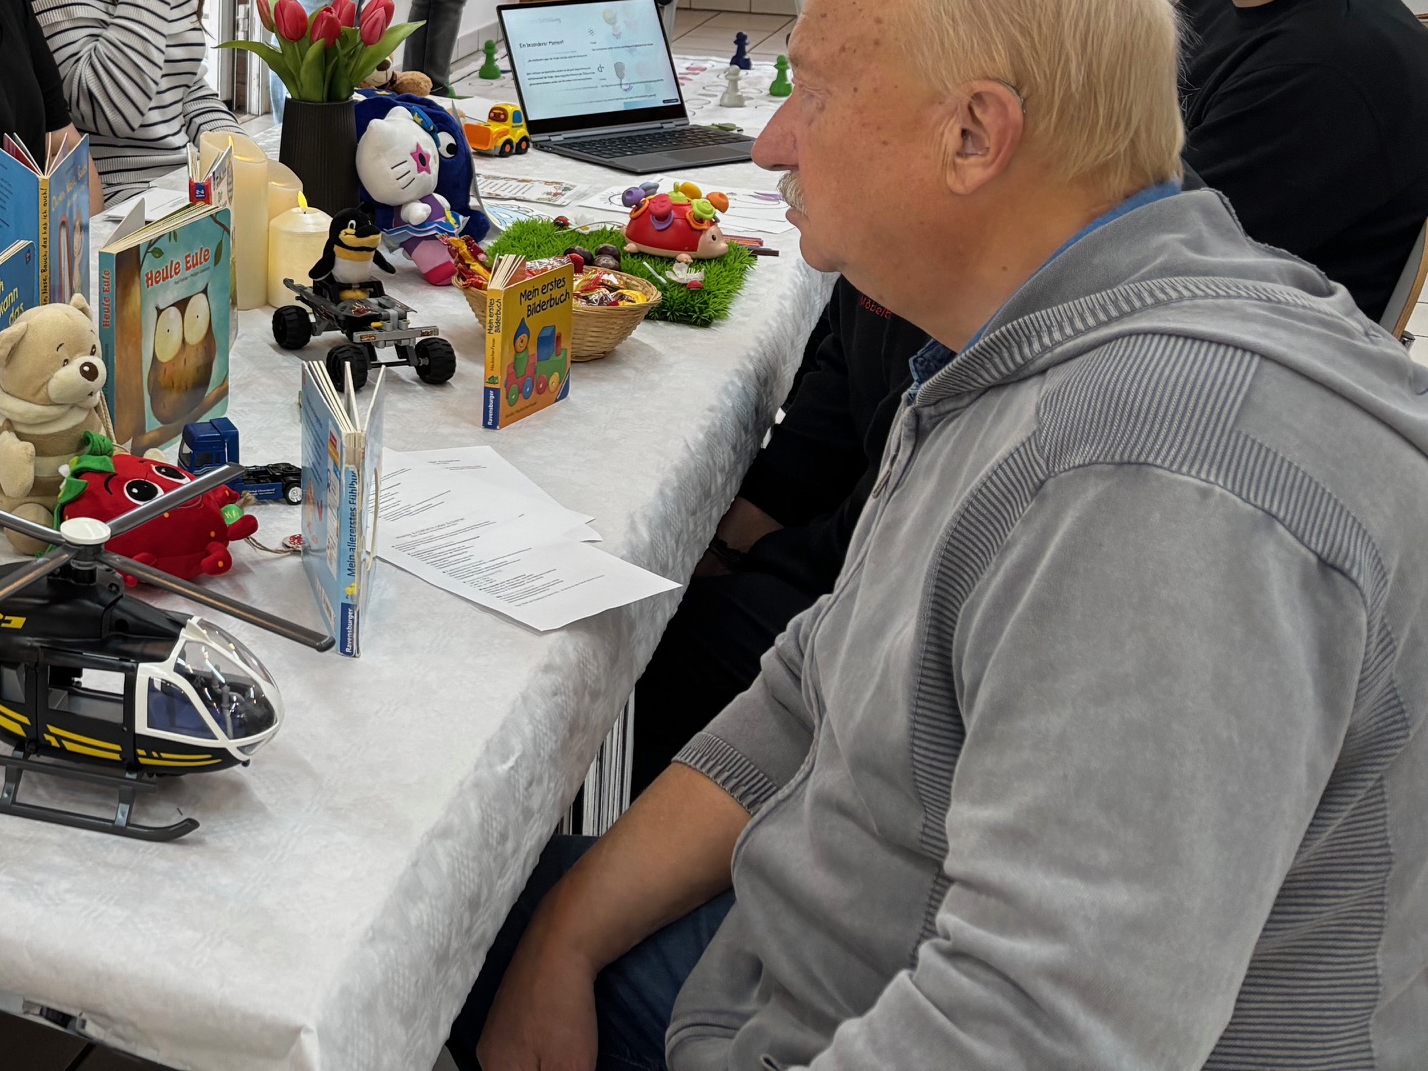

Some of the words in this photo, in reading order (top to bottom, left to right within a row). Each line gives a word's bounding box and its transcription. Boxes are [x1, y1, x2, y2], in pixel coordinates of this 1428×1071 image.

[102, 269, 111, 293] Eule
[145, 259, 181, 290] Heule
[185, 246, 211, 272] Eule
[487, 298, 495, 316] erstes
[519, 285, 540, 306] Mein
[541, 276, 567, 296] erstes
[526, 289, 571, 318] Bilderbuch
[102, 295, 111, 329] Heule
[487, 316, 495, 335] Mein
[494, 298, 502, 334] Bilderbuch
[487, 389, 495, 426] Ravensburger
[347, 504, 357, 556] allererstes
[347, 555, 356, 577] Mein
[345, 607, 354, 654] Ravensburger
